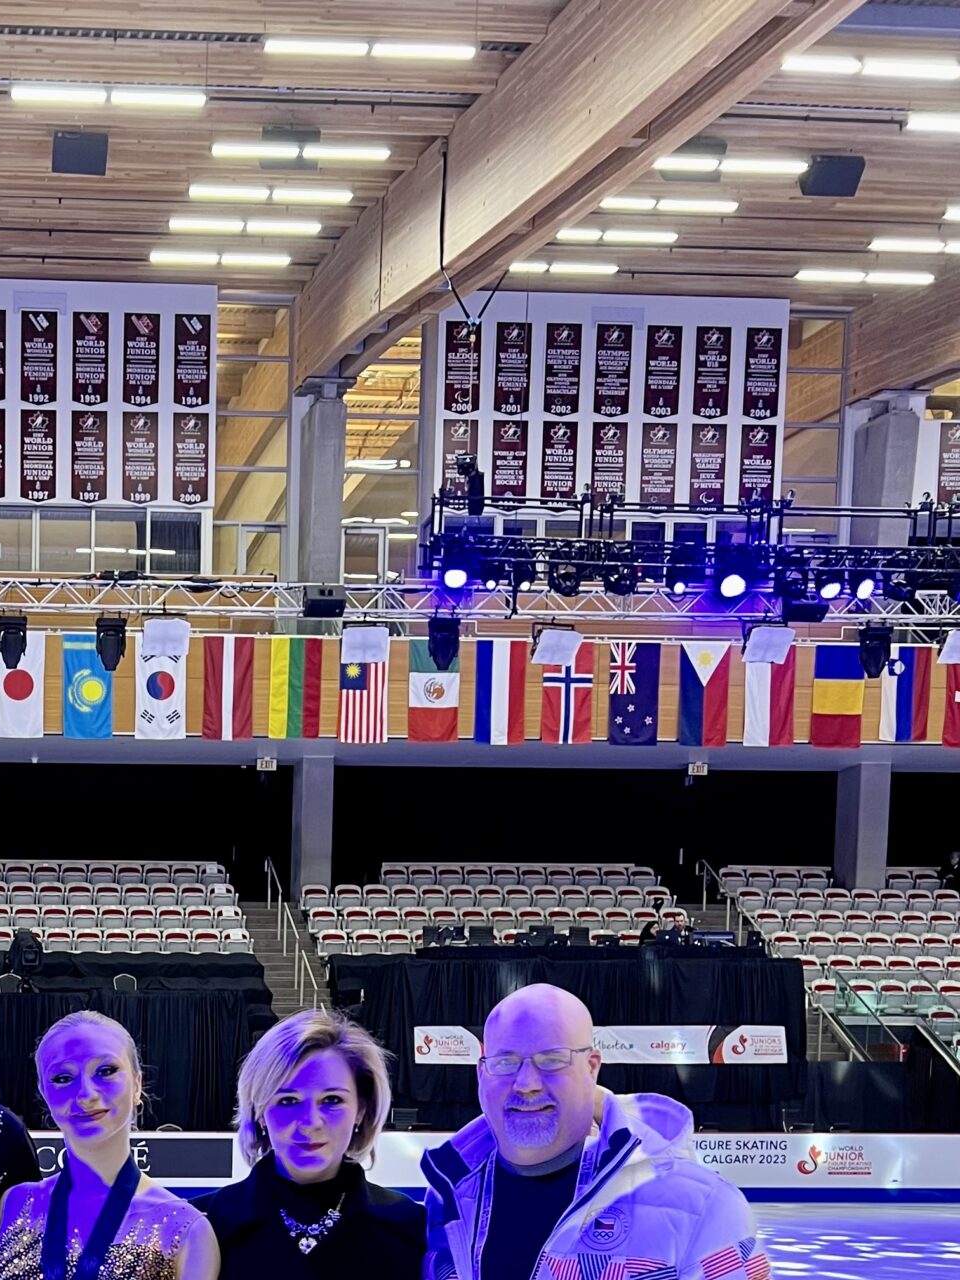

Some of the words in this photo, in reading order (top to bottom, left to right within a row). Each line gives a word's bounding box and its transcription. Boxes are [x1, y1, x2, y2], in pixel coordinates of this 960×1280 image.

[29, 394, 49, 402] 1992
[80, 395, 100, 403] 1993
[131, 396, 151, 404] 1994
[182, 397, 202, 405] 1994
[452, 403, 472, 411] 2000
[501, 404, 521, 413] 2001
[601, 406, 621, 414] 2002
[700, 408, 720, 416] 2003
[750, 409, 770, 417] 2004
[28, 491, 48, 499] 1997
[79, 492, 99, 500] 1997
[130, 493, 150, 501] 1999
[180, 494, 201, 502] 2000
[434, 1040, 464, 1048] JUNIOR
[651, 1041, 686, 1050] calgary
[736, 1141, 787, 1150] SKATING
[704, 1155, 754, 1163] CALGARY
[759, 1155, 786, 1164] 2023
[823, 1152, 864, 1163] JUNIOR
